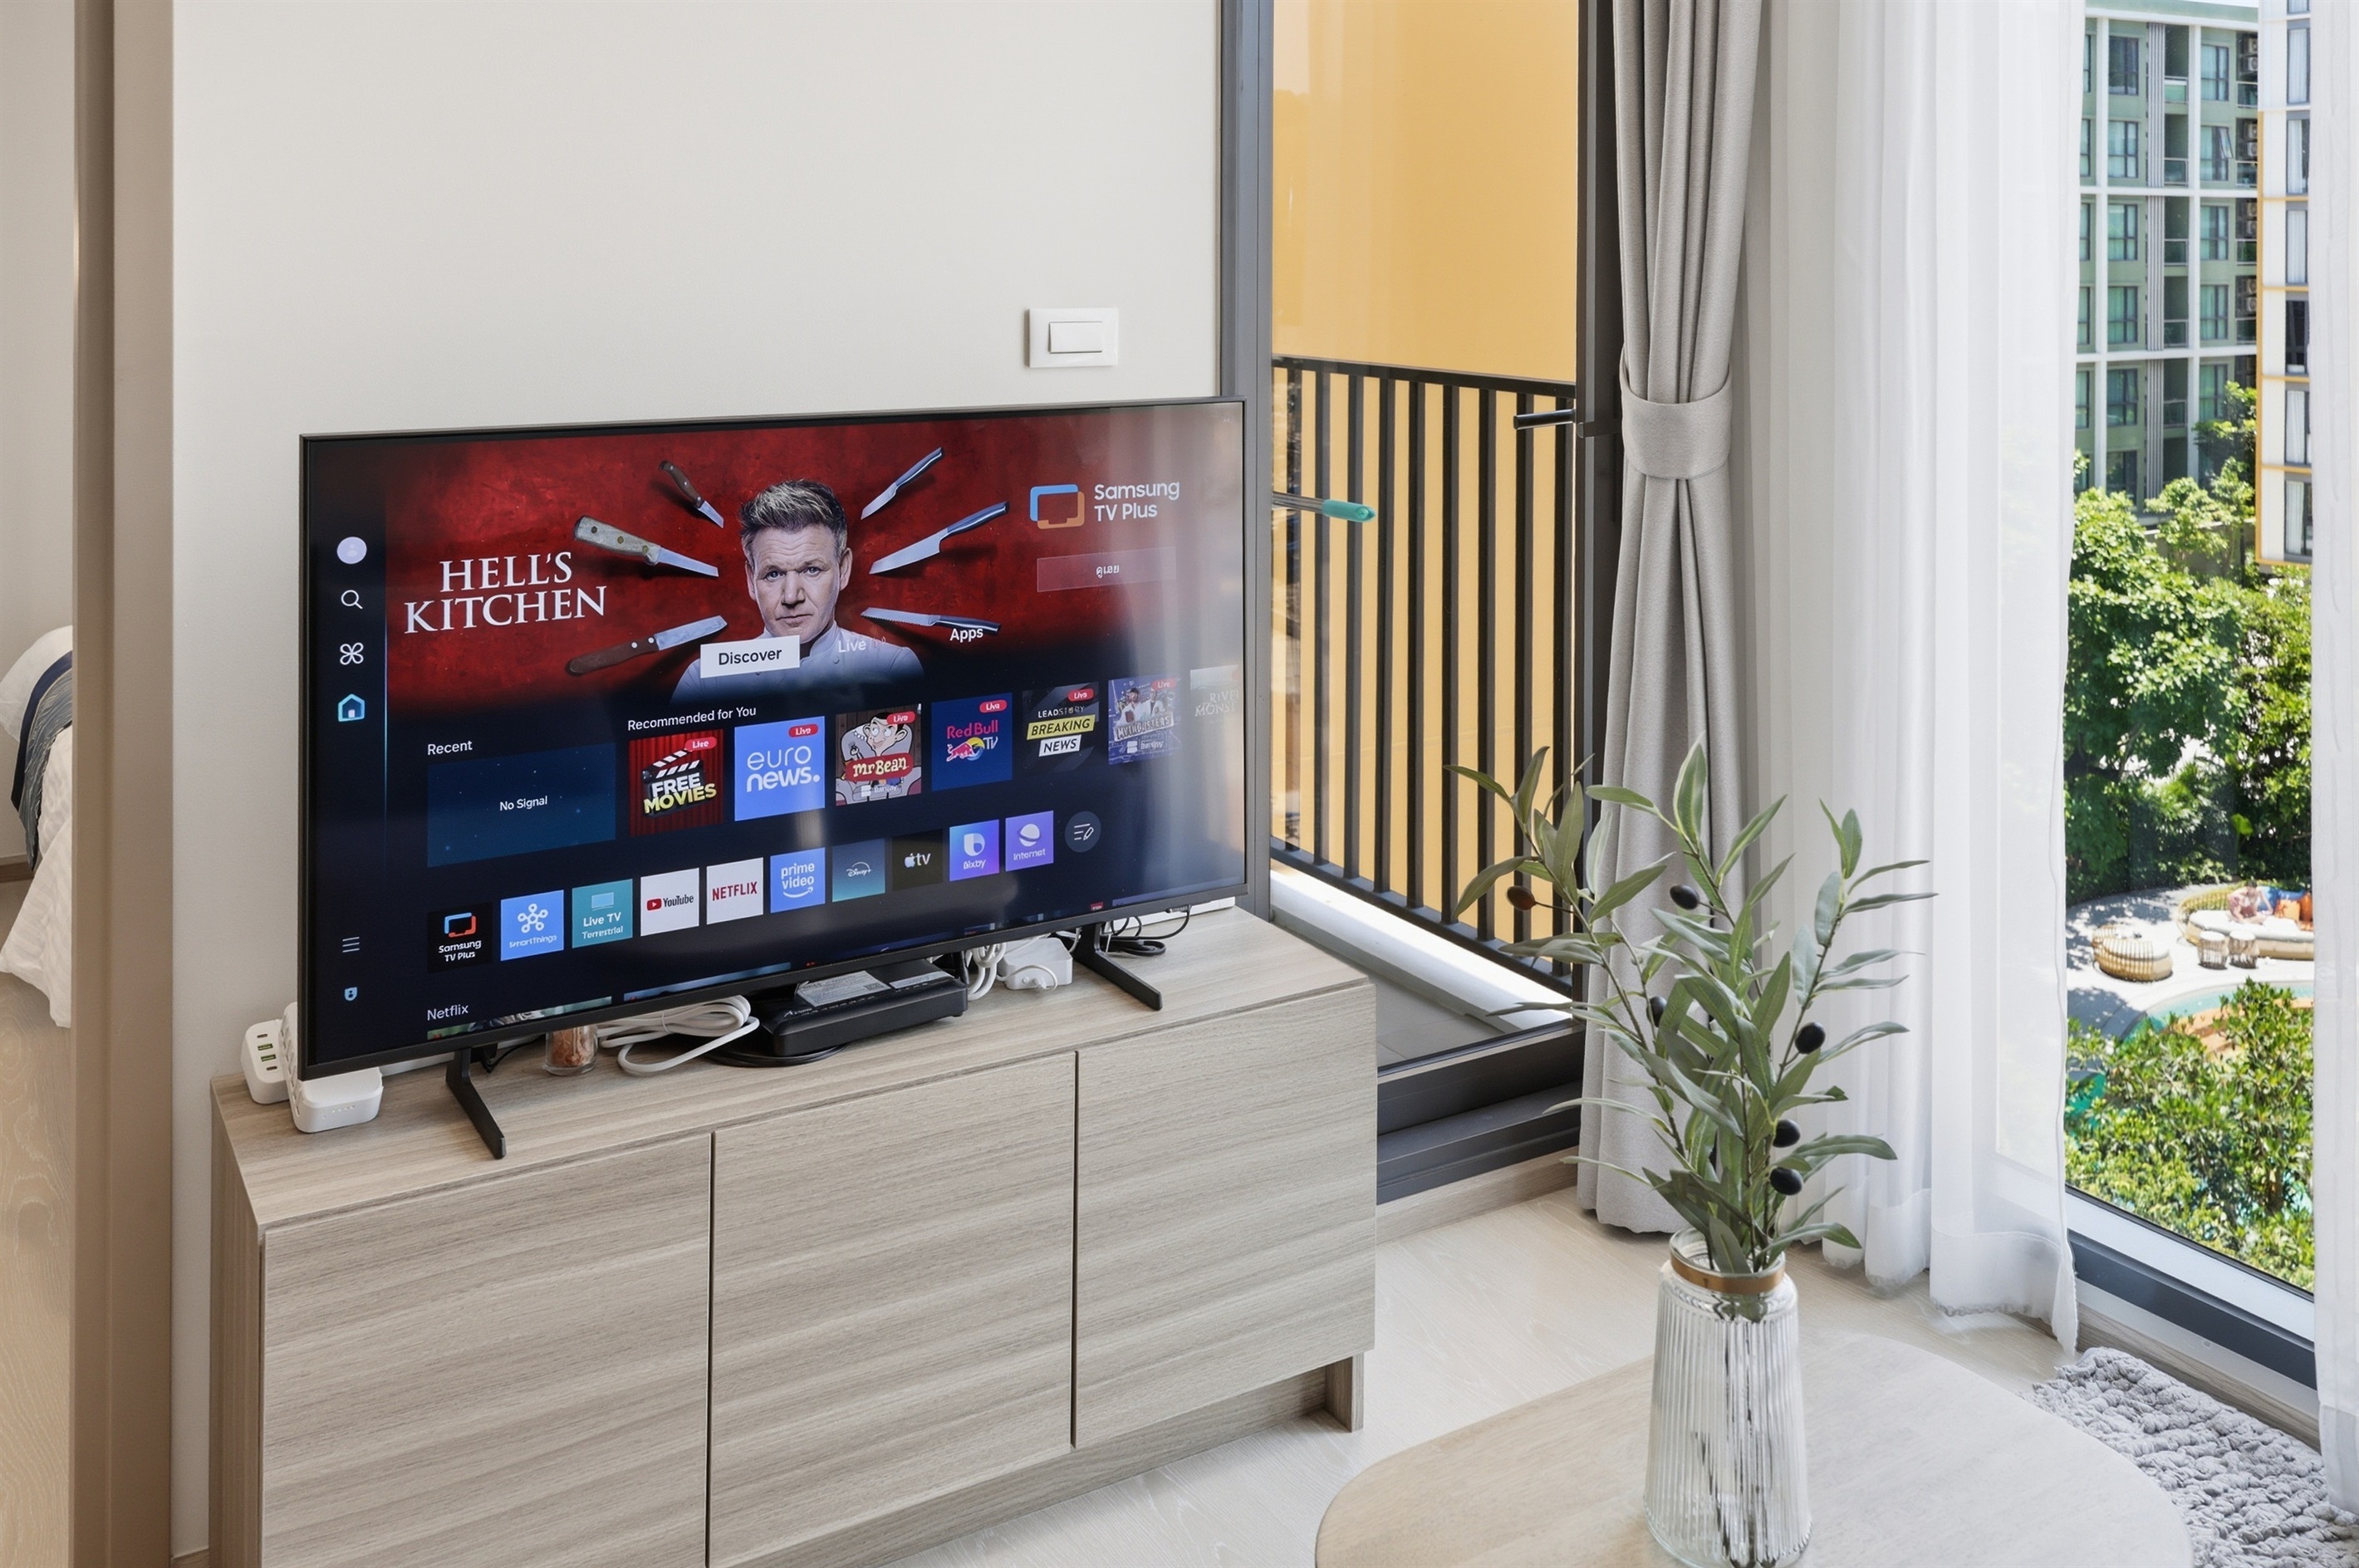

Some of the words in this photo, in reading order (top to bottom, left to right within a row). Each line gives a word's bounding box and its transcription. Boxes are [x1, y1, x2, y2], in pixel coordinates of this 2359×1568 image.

[1094, 482, 1180, 501] Samsung
[1094, 504, 1119, 522] TV
[1122, 502, 1158, 520] Plus
[439, 551, 572, 591] HELL'S
[404, 585, 607, 634] KITCHEN
[949, 627, 984, 642] Apps
[837, 638, 866, 654] Live
[718, 647, 782, 666] Discover
[1157, 680, 1170, 688] Live
[1073, 691, 1088, 700] Live
[985, 702, 1000, 711] Live
[627, 710, 714, 731] Recommended
[717, 708, 733, 721] for
[736, 706, 757, 718] You
[893, 713, 909, 723] Live
[795, 727, 812, 736] Live
[947, 723, 972, 739] Red
[974, 719, 999, 737] Bull
[1031, 718, 1091, 736] BREAKING
[427, 740, 473, 755] Recent
[692, 741, 709, 749] Live
[983, 736, 998, 750] TV
[1043, 738, 1077, 753] NEWS
[747, 745, 812, 771] euro
[651, 772, 701, 798] FREE
[746, 766, 821, 793] news.
[499, 801, 515, 811] No
[516, 795, 548, 810] Signal
[643, 782, 718, 814] MOVIES
[1013, 848, 1046, 861] Internet
[781, 861, 815, 880] prime
[964, 859, 986, 870] Bixby
[782, 875, 814, 889] video
[712, 881, 758, 902] NETFLIX
[663, 894, 694, 908] YouTube
[583, 917, 605, 928] Live
[607, 912, 622, 924] TV
[582, 925, 623, 939] Terrestrial
[439, 939, 482, 953] Samsung
[444, 953, 456, 963] TV
[458, 951, 476, 961] Plus
[427, 1004, 468, 1022] Netflix
